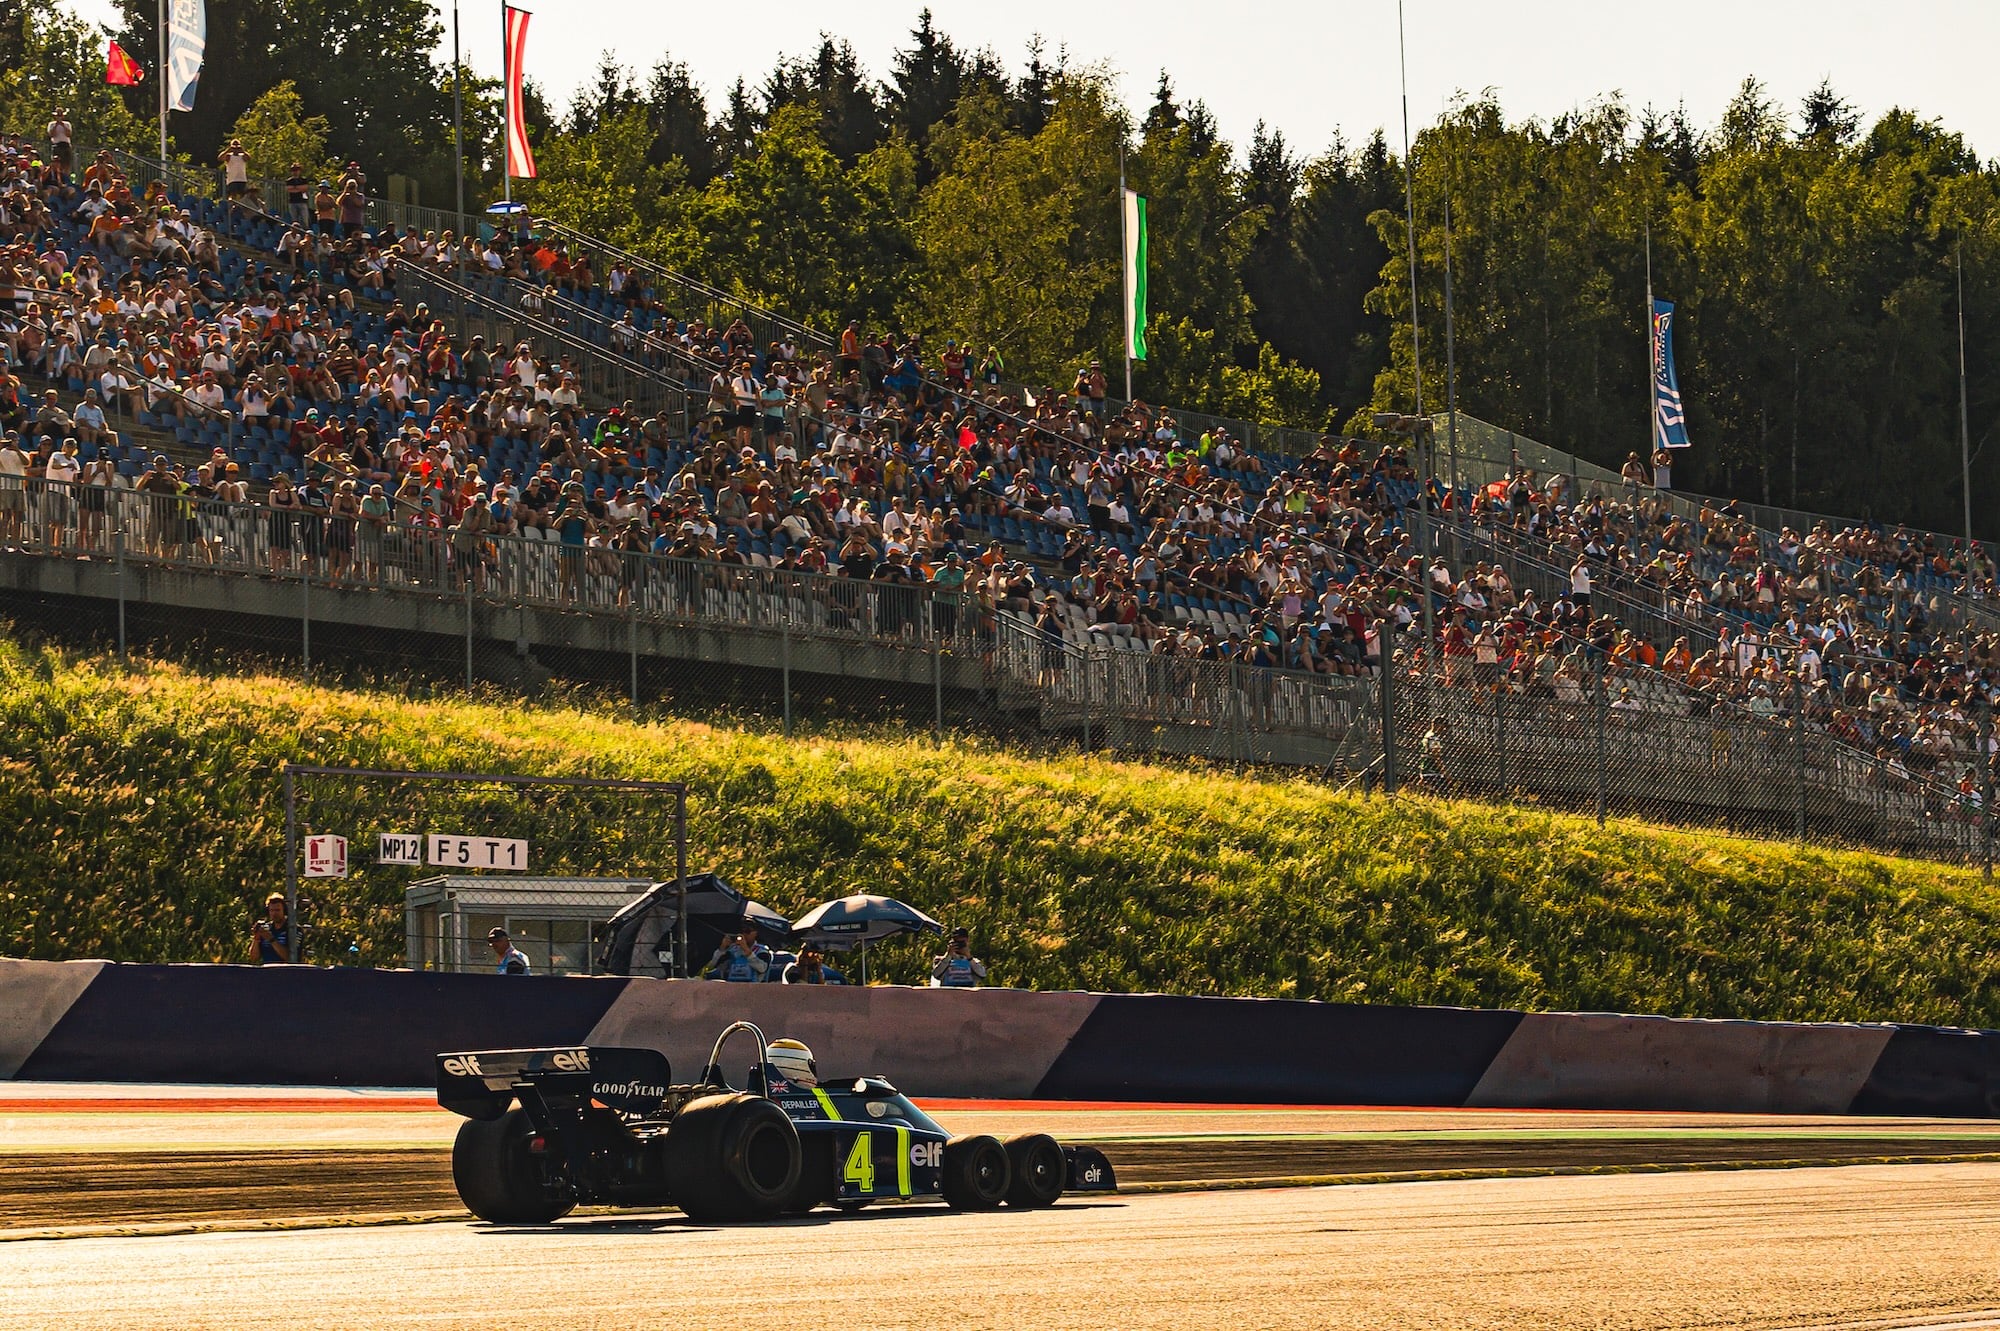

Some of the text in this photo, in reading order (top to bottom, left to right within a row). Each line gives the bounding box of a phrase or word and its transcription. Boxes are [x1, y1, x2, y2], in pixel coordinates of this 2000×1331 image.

[382, 838, 418, 861] MP1.2
[443, 1055, 483, 1076] elf
[553, 1050, 590, 1071] elf
[593, 1080, 665, 1098] GOODYEAR
[781, 1100, 820, 1109] DEPAILLER
[843, 1131, 874, 1192] 4
[910, 1142, 943, 1167] elf
[1084, 1168, 1101, 1183] elf
